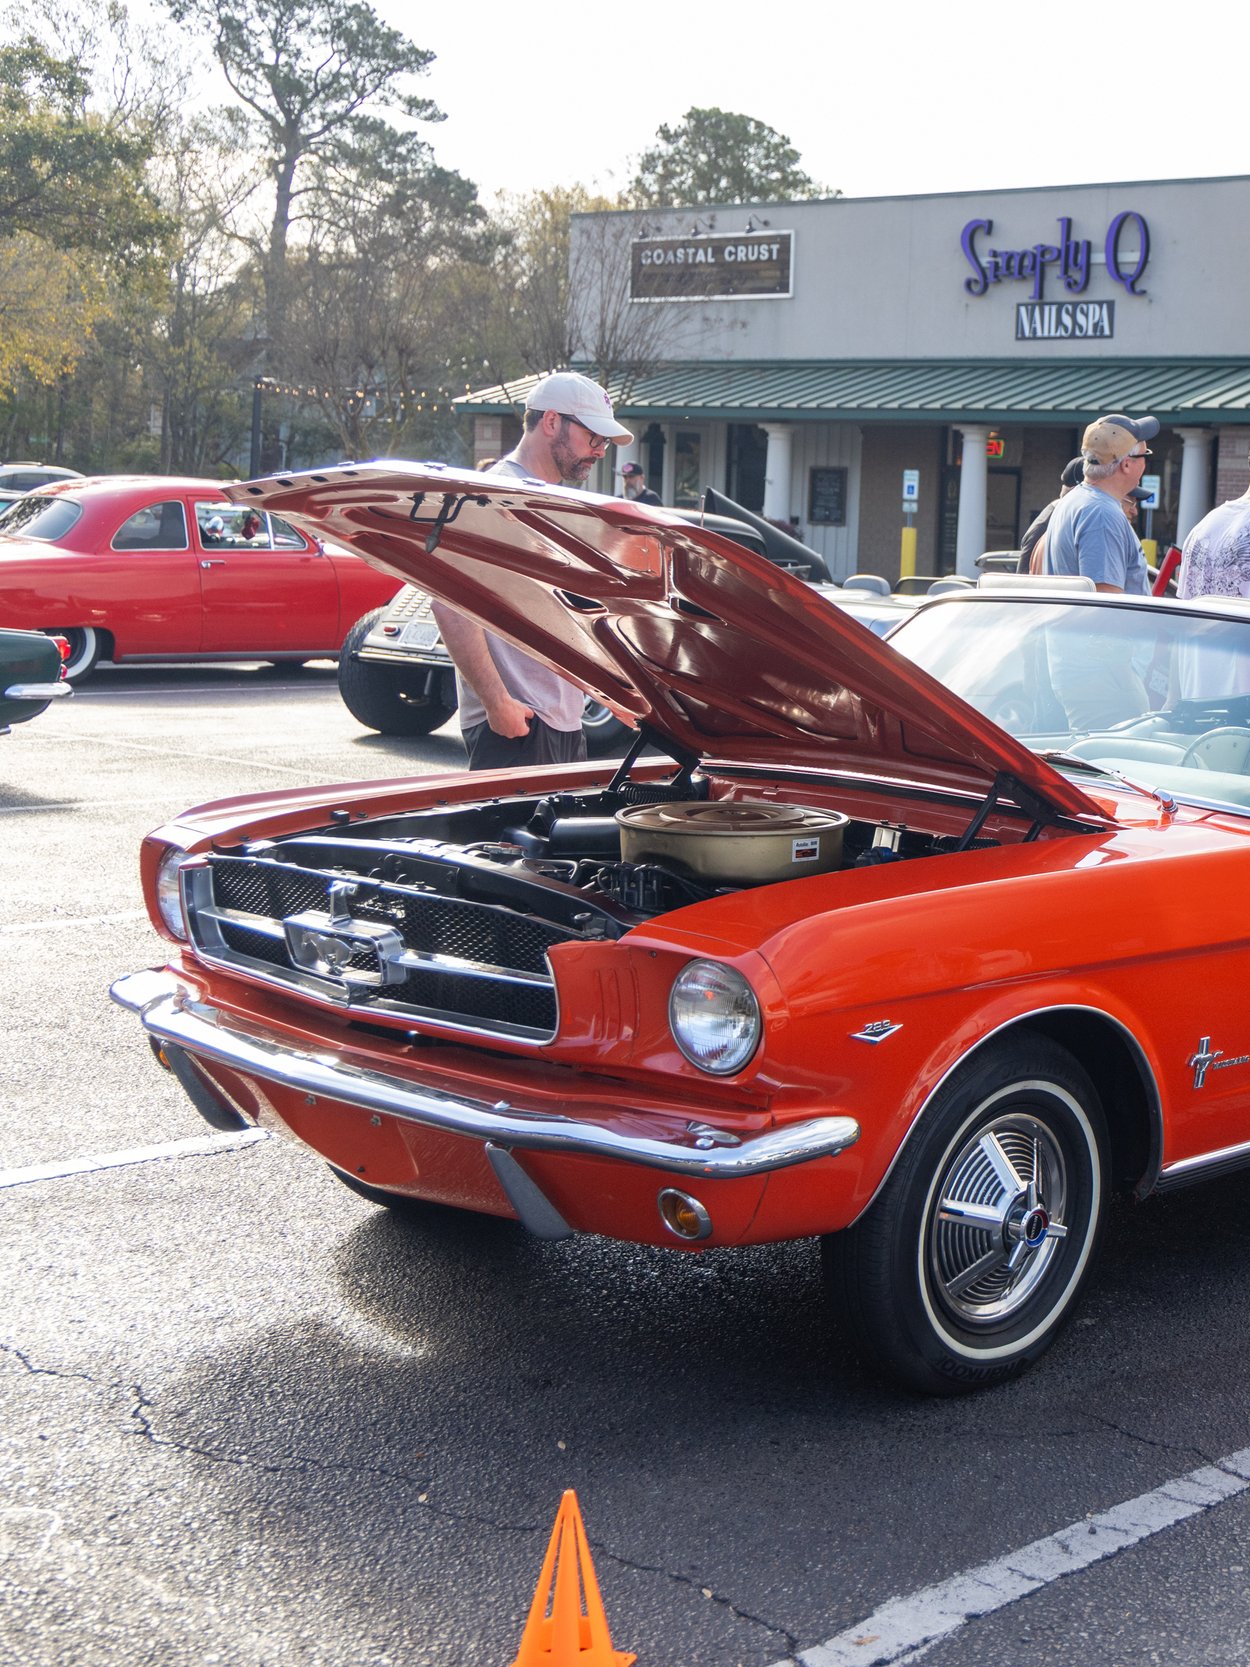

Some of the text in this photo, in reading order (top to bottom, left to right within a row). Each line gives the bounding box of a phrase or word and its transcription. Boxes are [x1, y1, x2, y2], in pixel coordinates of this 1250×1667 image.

[640, 244, 780, 265] COASTAL CRUST
[960, 211, 1151, 301] Simply Q
[1017, 303, 1112, 338] NAILS SPA
